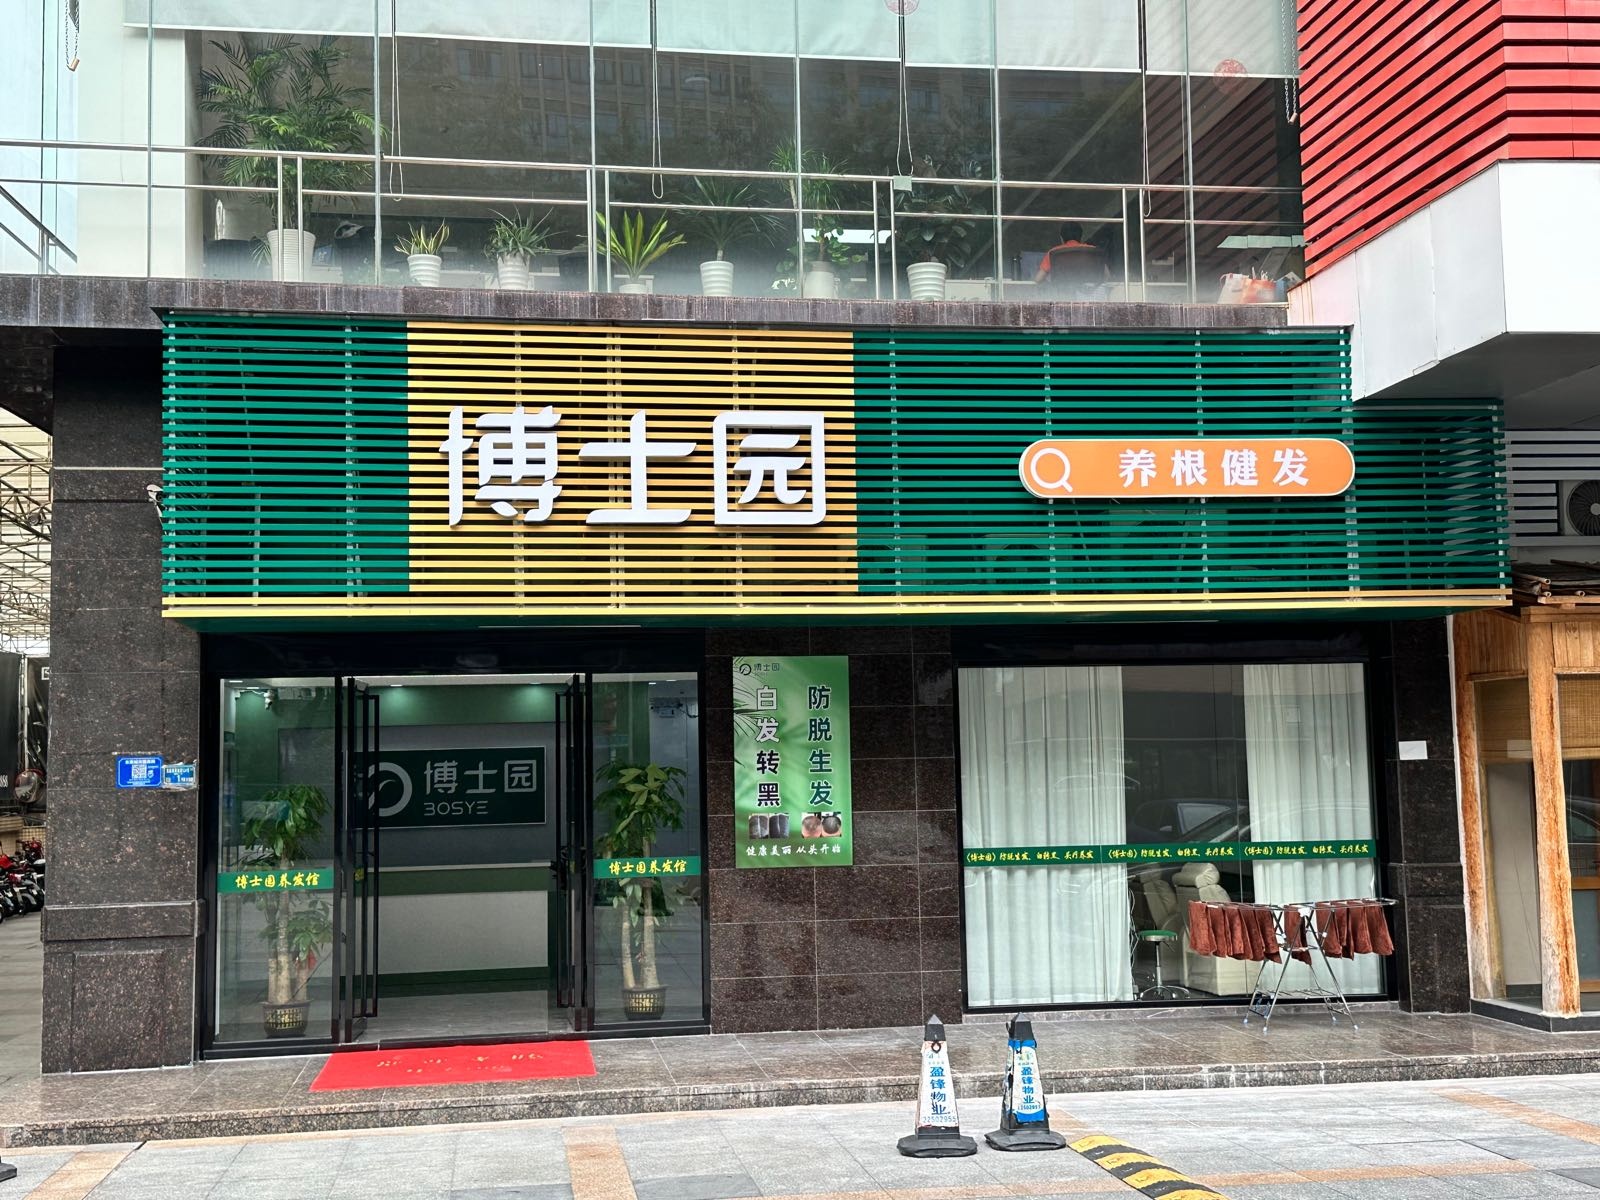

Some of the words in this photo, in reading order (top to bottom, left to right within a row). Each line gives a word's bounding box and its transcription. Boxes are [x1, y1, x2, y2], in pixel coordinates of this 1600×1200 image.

[438, 405, 826, 526] 博士园
[1118, 447, 1310, 488] 养根健发
[755, 684, 781, 808] 白发转黑
[807, 684, 834, 807] 防脱生发
[423, 759, 537, 795] 博士园
[235, 872, 320, 889] 博士园养发馆
[608, 859, 687, 876] 博士园养发馆
[929, 1066, 949, 1115] 盈锋物业
[1020, 1066, 1036, 1104] 盈锋物业
